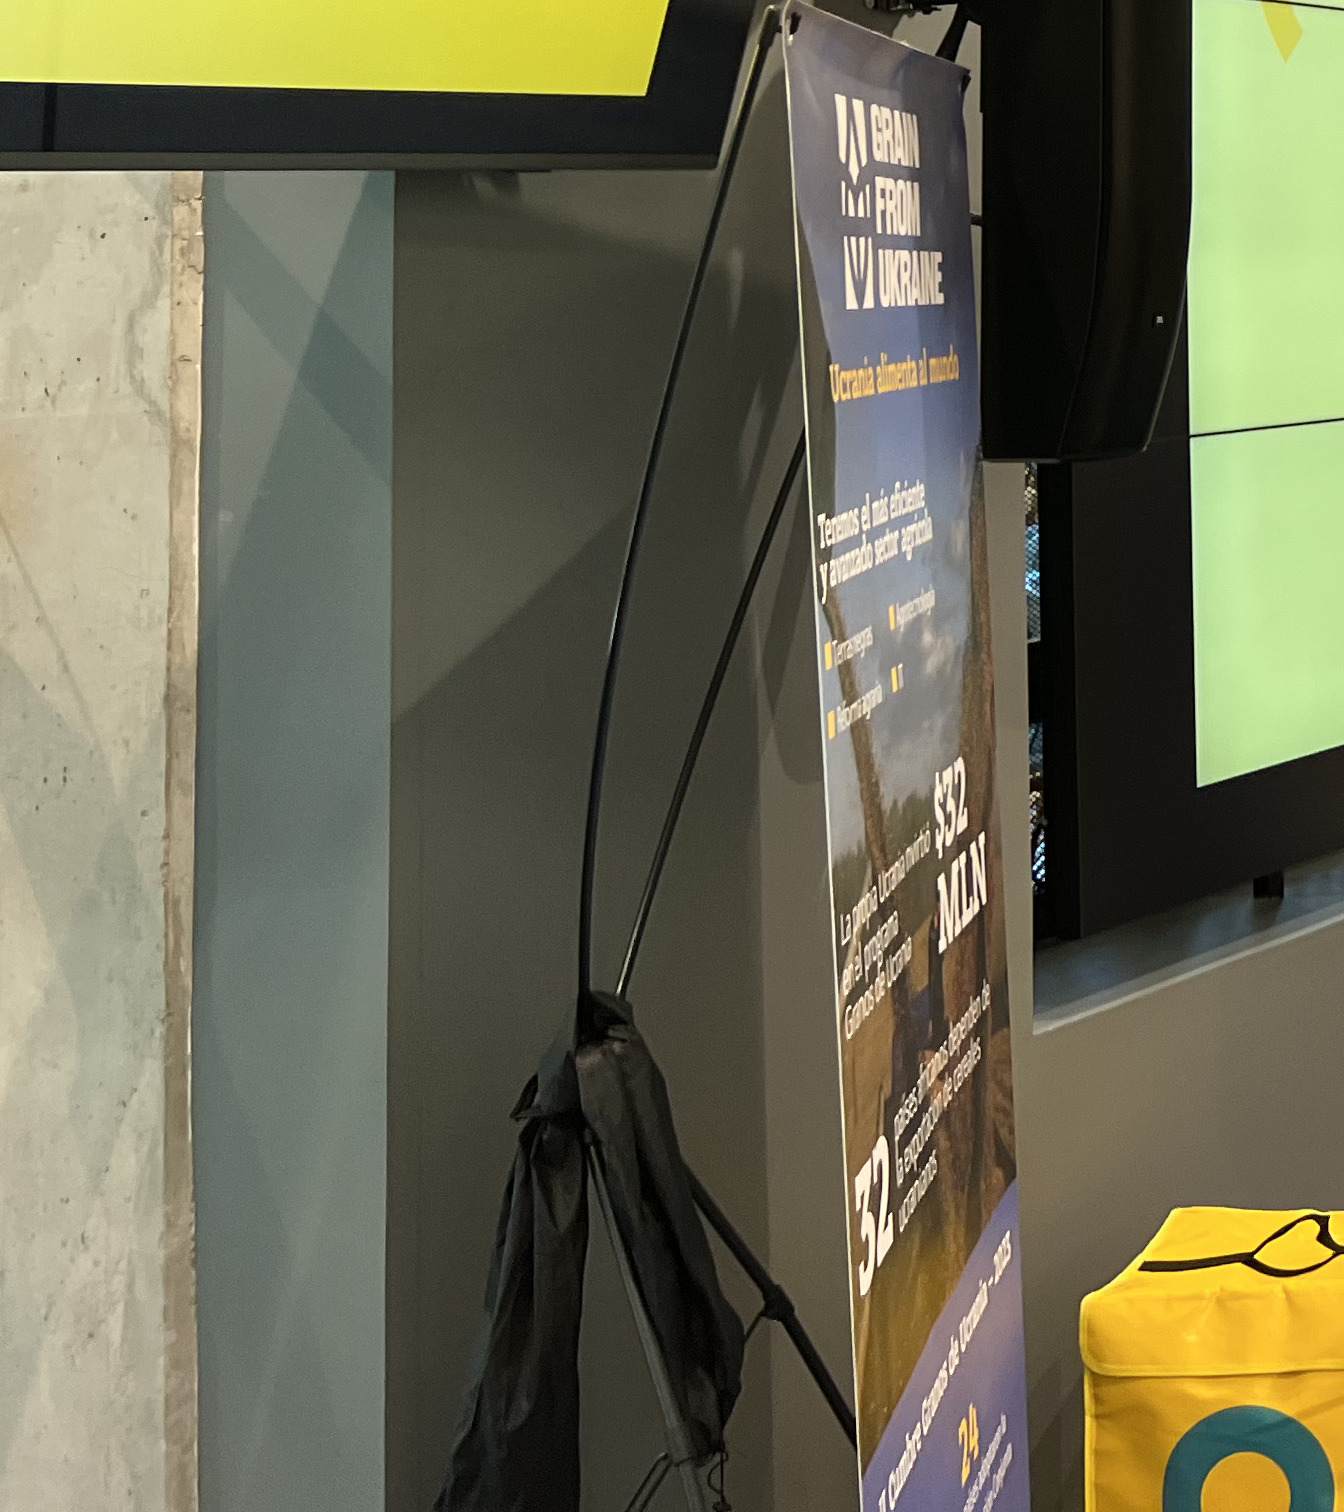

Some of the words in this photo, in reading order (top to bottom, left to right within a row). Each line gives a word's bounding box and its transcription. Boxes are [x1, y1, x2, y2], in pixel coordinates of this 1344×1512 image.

[870, 103, 920, 169] GRAIN
[874, 175, 921, 238] FROM
[877, 249, 945, 309] UKRAINE
[829, 356, 875, 403] Ucrania
[819, 562, 830, 605] y
[934, 756, 969, 860] $32
[937, 831, 988, 955] MLN
[854, 1134, 894, 1297] 32
[958, 1402, 979, 1488] 24
